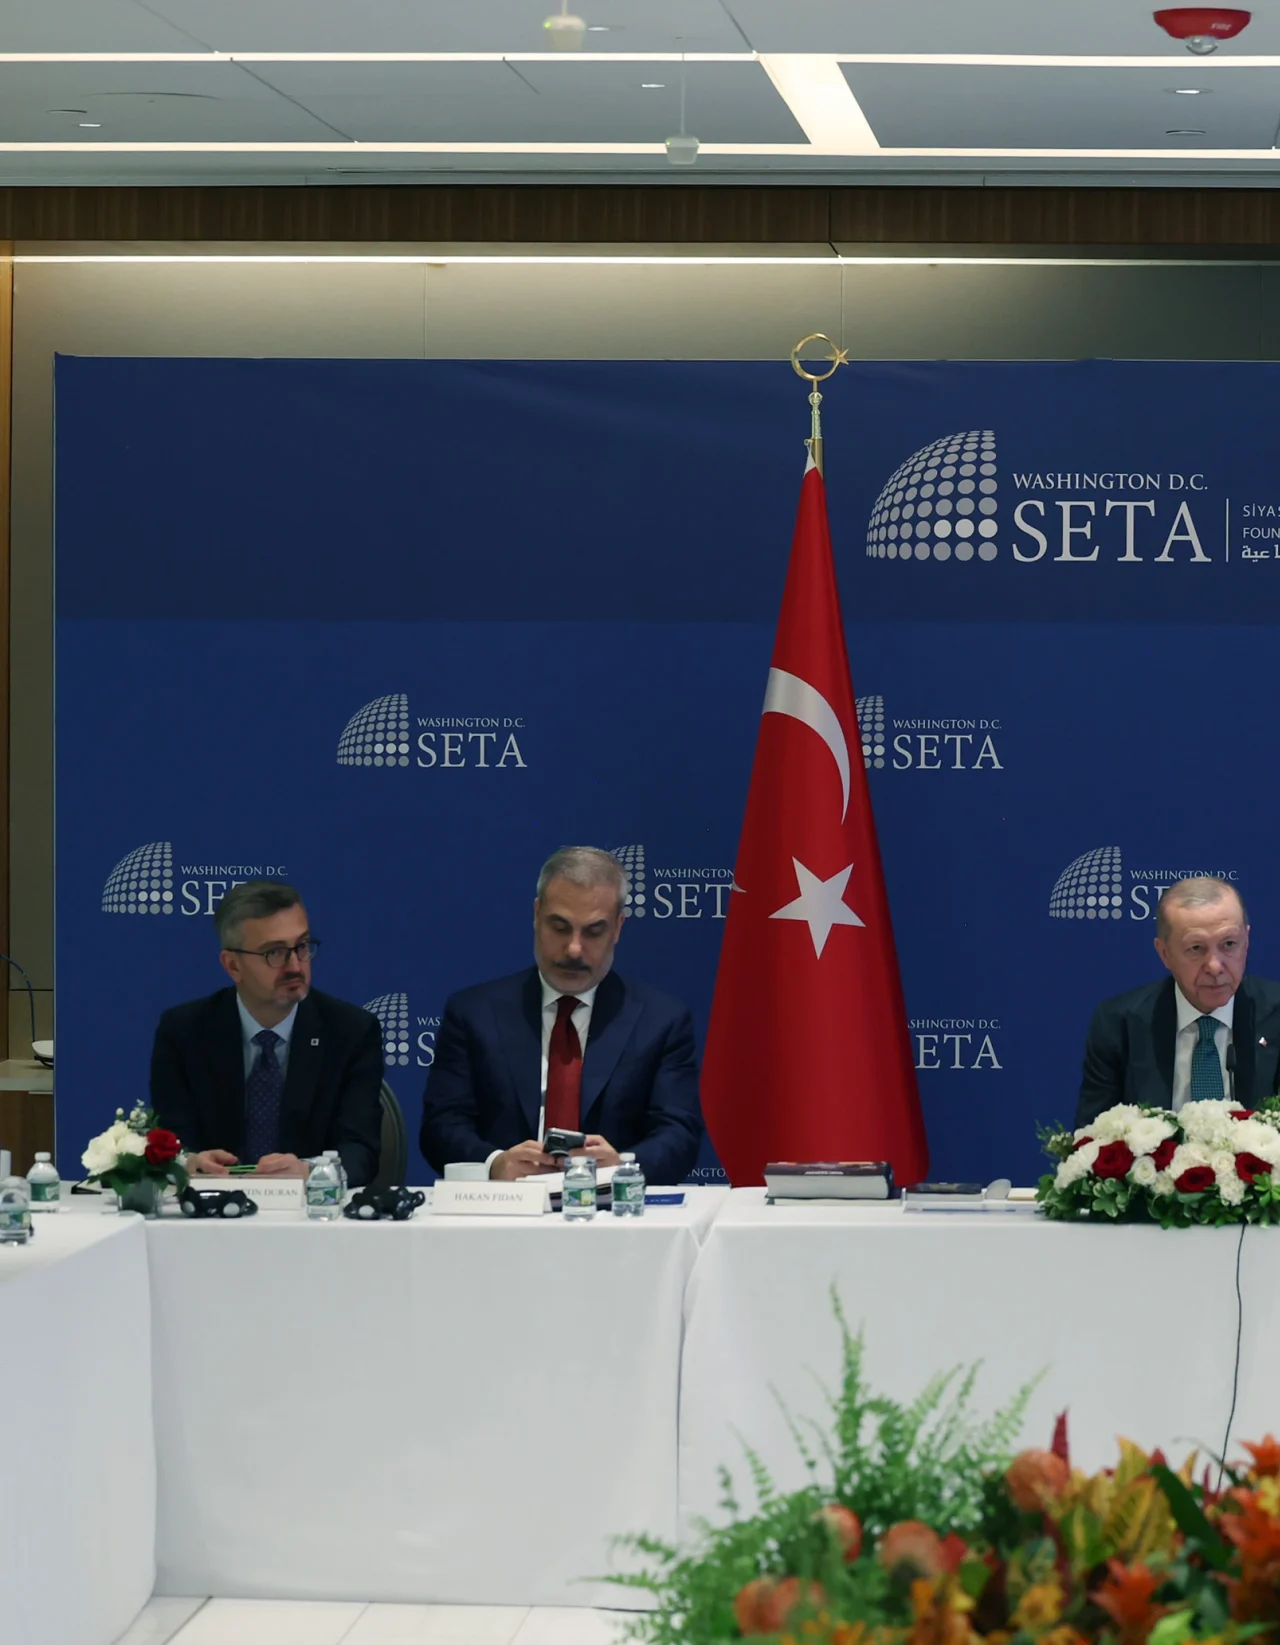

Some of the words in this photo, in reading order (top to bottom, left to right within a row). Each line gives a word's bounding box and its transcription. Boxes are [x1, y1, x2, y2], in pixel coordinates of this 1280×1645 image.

[1012, 472, 1161, 490] WASHINGTON
[1169, 473, 1208, 491] D.C.
[1011, 498, 1212, 563] SETA
[417, 717, 500, 728] WASHINGTON
[503, 717, 526, 728] D.C.
[892, 719, 976, 730] WASHINGTON
[979, 719, 1002, 730] D.C.
[416, 732, 528, 768] SETA
[892, 734, 1004, 770] SETA
[180, 865, 262, 876] WASHINGTON
[266, 865, 288, 876] D.C.
[1217, 870, 1240, 880] D.C.
[653, 883, 733, 919] SET
[908, 1019, 975, 1029] SHINGTON
[978, 1019, 1001, 1029] D.C.
[914, 1033, 1004, 1069] ETA
